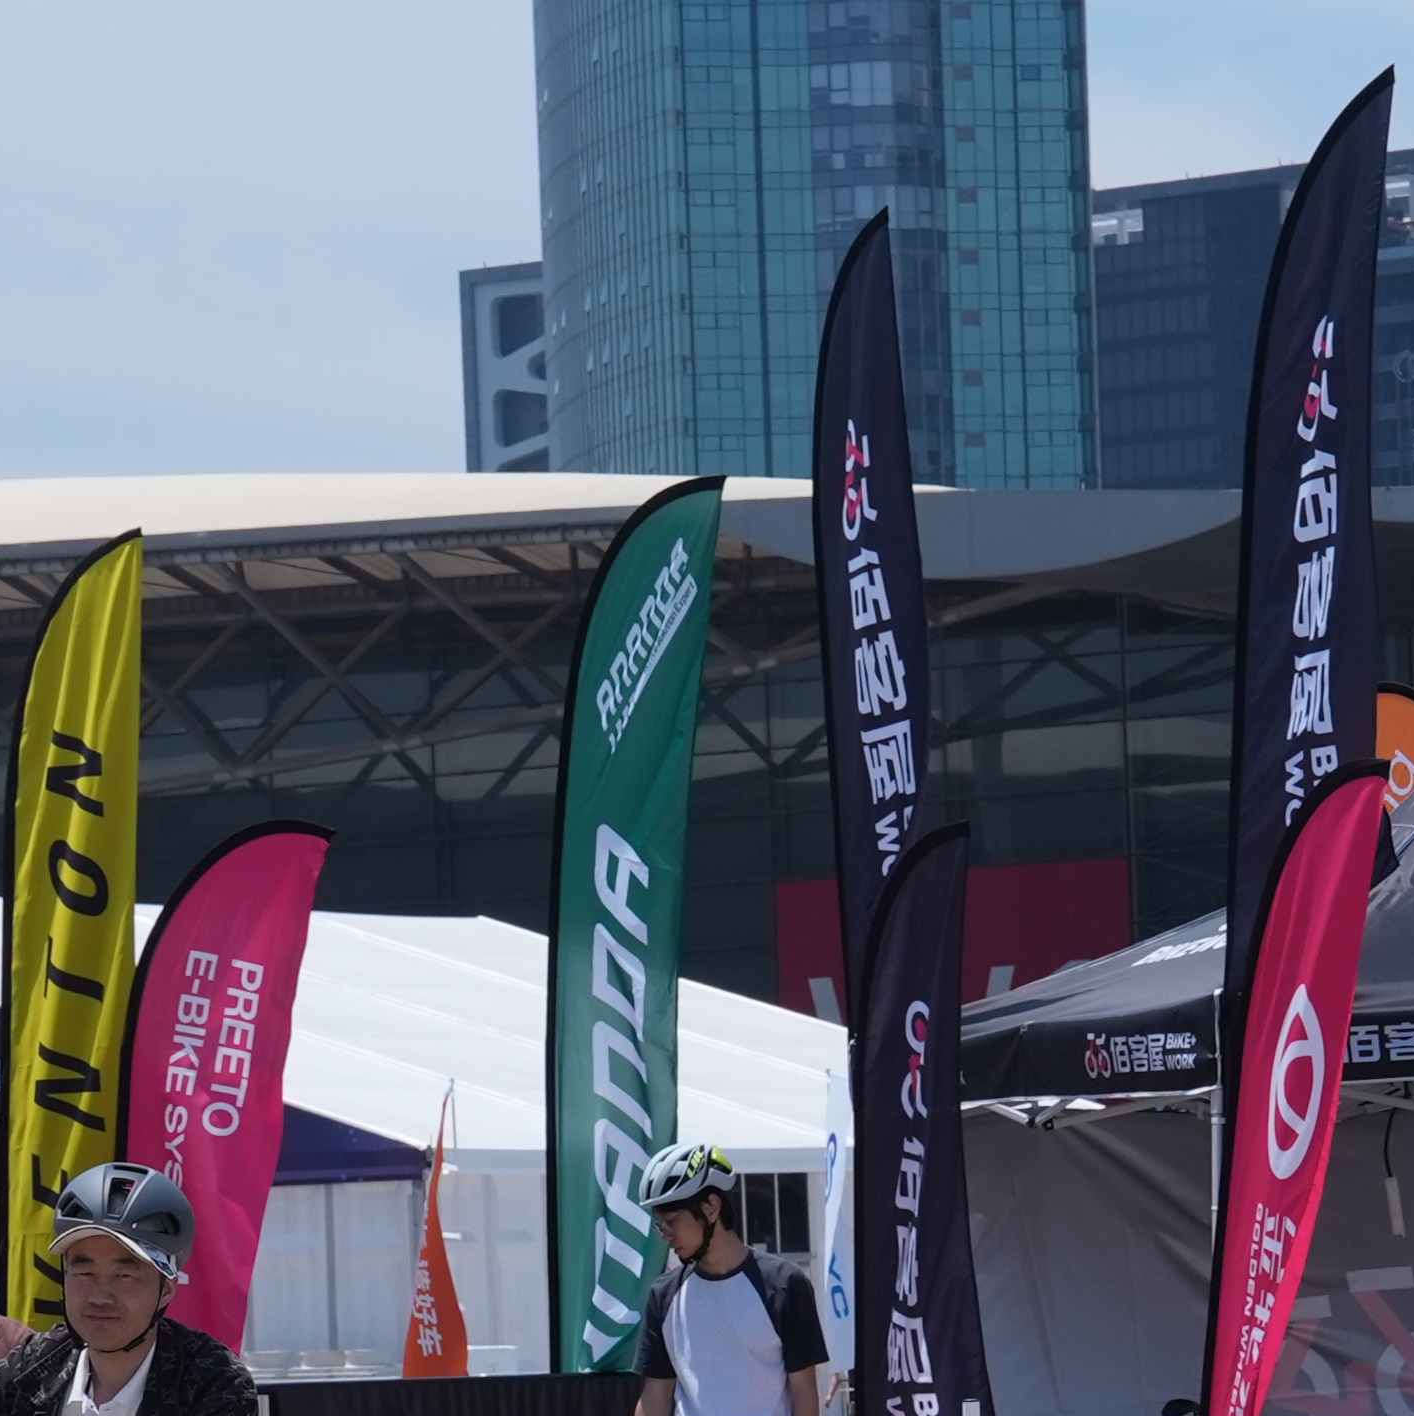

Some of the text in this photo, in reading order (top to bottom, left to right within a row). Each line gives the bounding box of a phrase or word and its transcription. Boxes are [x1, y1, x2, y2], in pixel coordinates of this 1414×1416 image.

[847, 546, 918, 806] 佰客屋
[166, 948, 219, 1097] E-BIKE
[201, 958, 265, 1138] PREETO
[1110, 1033, 1165, 1075] 佰客屋
[1165, 1032, 1198, 1051] BIKE+
[1165, 1051, 1197, 1072] WORK
[1243, 1202, 1264, 1316] GOLDEN
